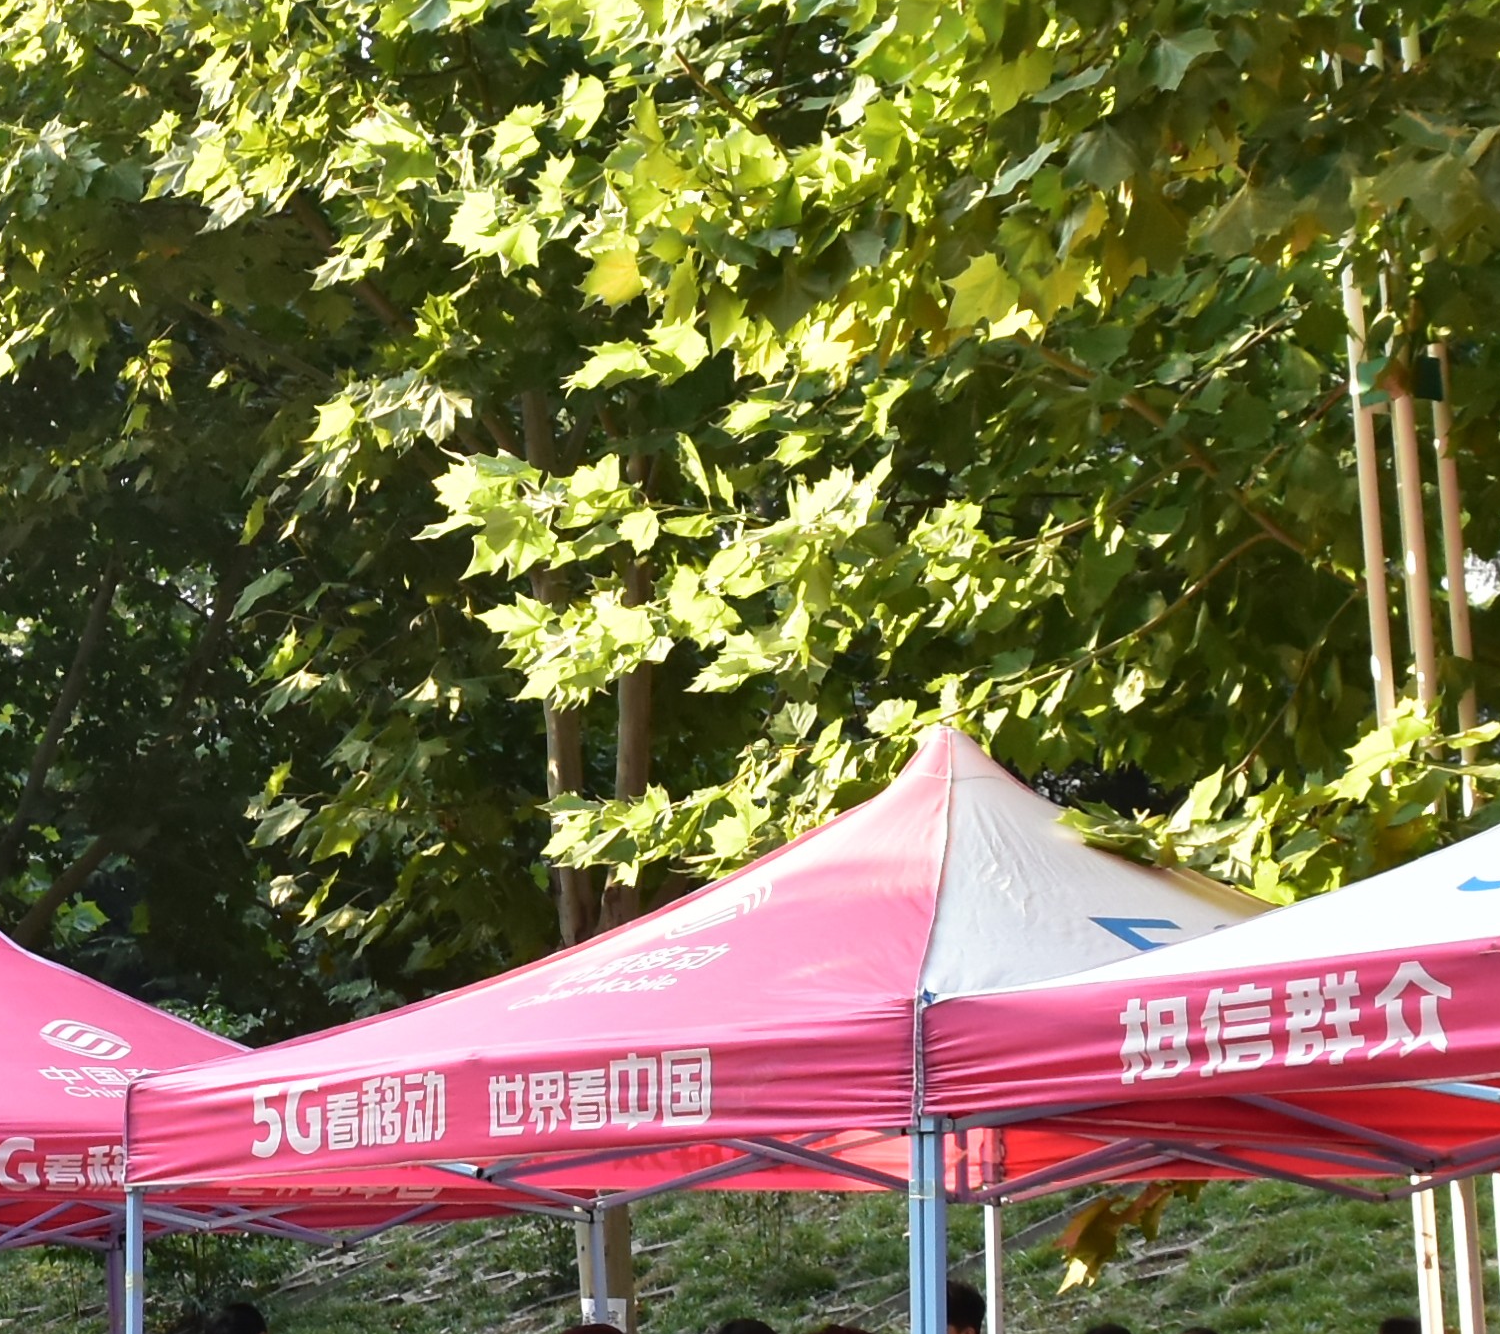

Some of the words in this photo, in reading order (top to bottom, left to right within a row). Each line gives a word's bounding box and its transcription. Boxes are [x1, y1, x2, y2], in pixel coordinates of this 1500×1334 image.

[1119, 960, 1453, 1085] 相信群众
[252, 1069, 446, 1159] 5G看移动
[487, 1046, 712, 1138] 世界看中国
